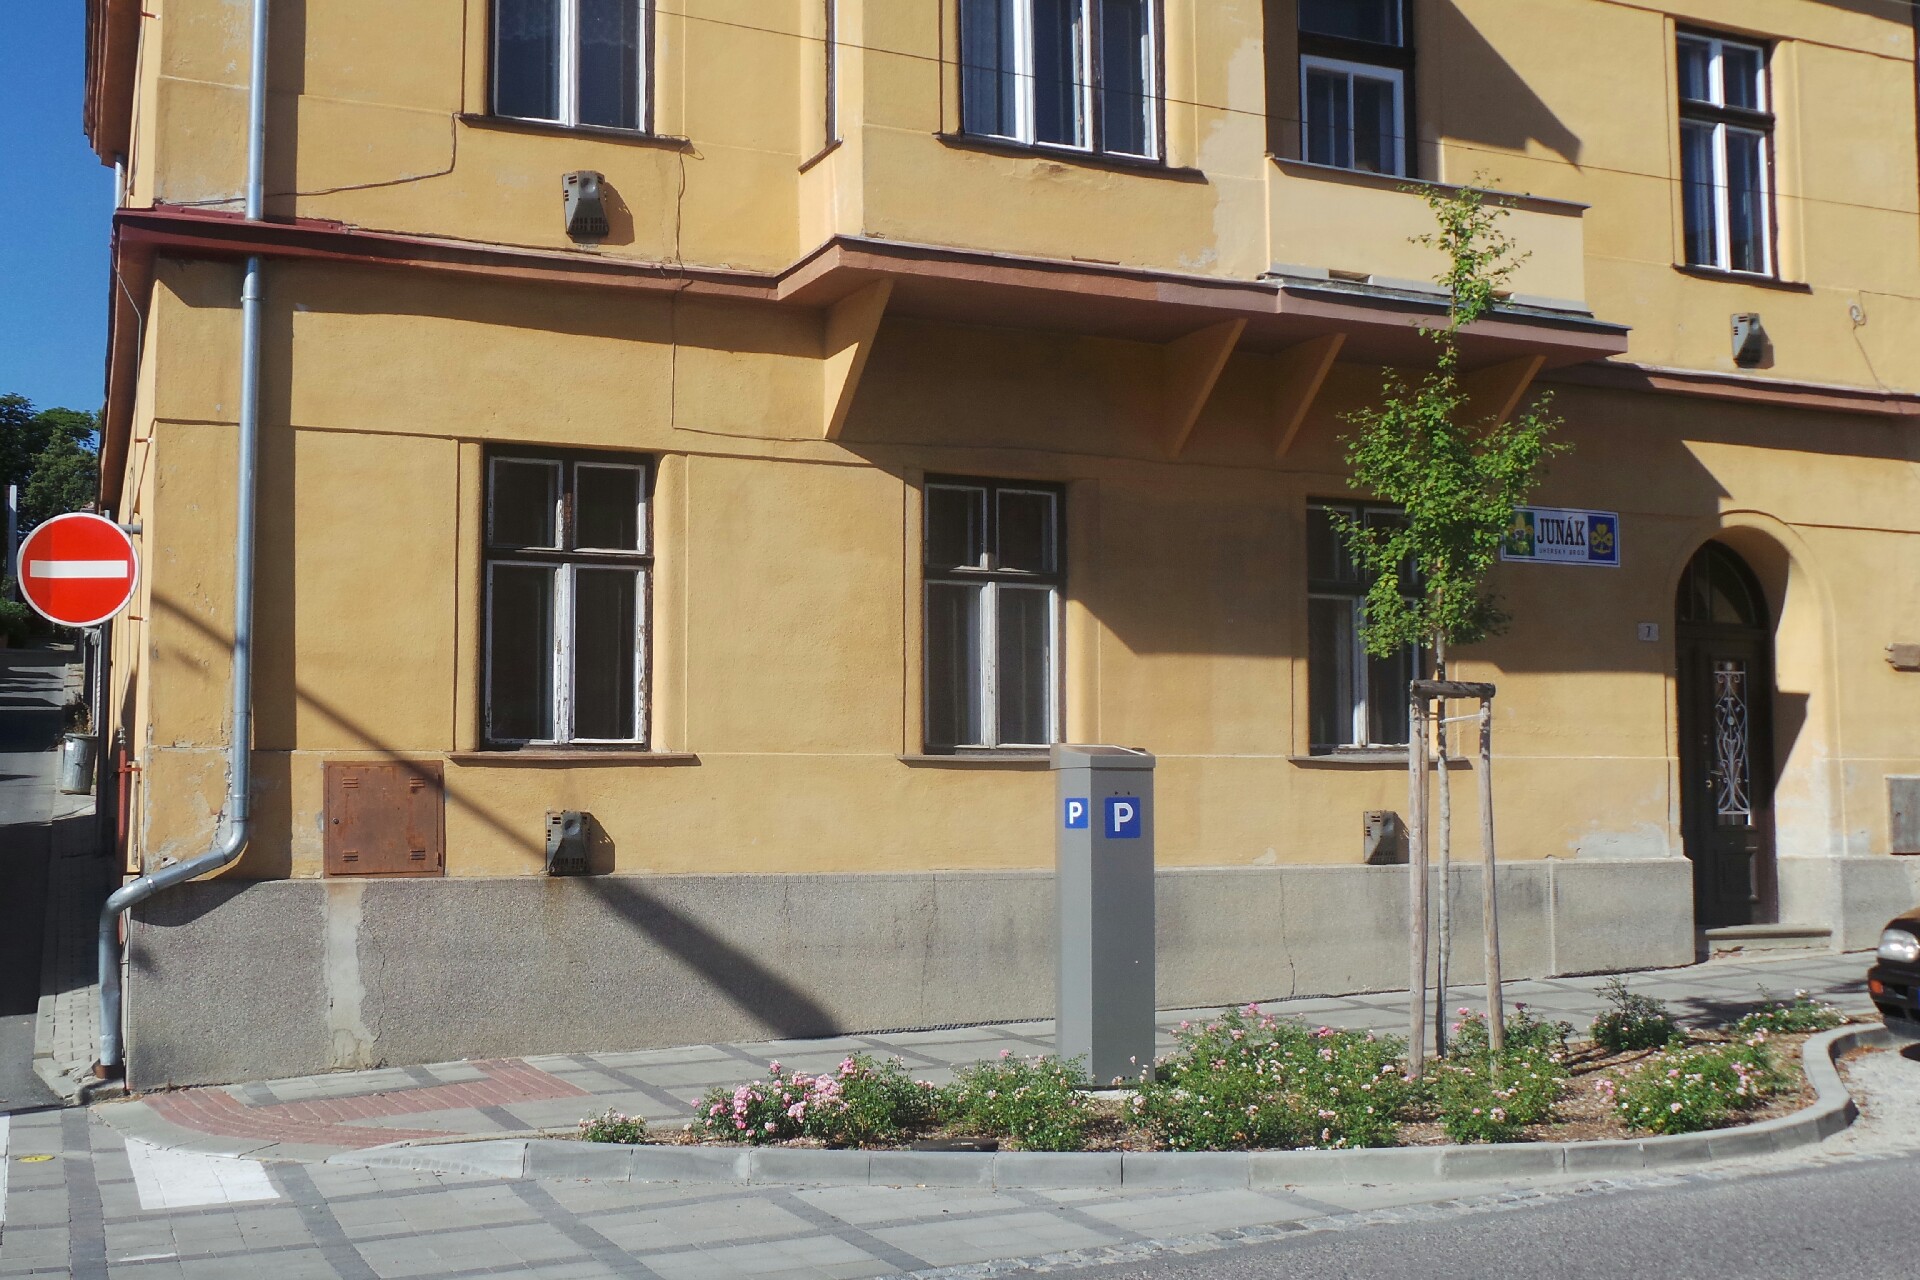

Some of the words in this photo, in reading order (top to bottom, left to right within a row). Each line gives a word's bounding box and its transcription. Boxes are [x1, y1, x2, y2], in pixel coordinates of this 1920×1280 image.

[1537, 516, 1585, 546] JUNÁK
[1069, 801, 1083, 824] P
[1113, 802, 1133, 832] P
